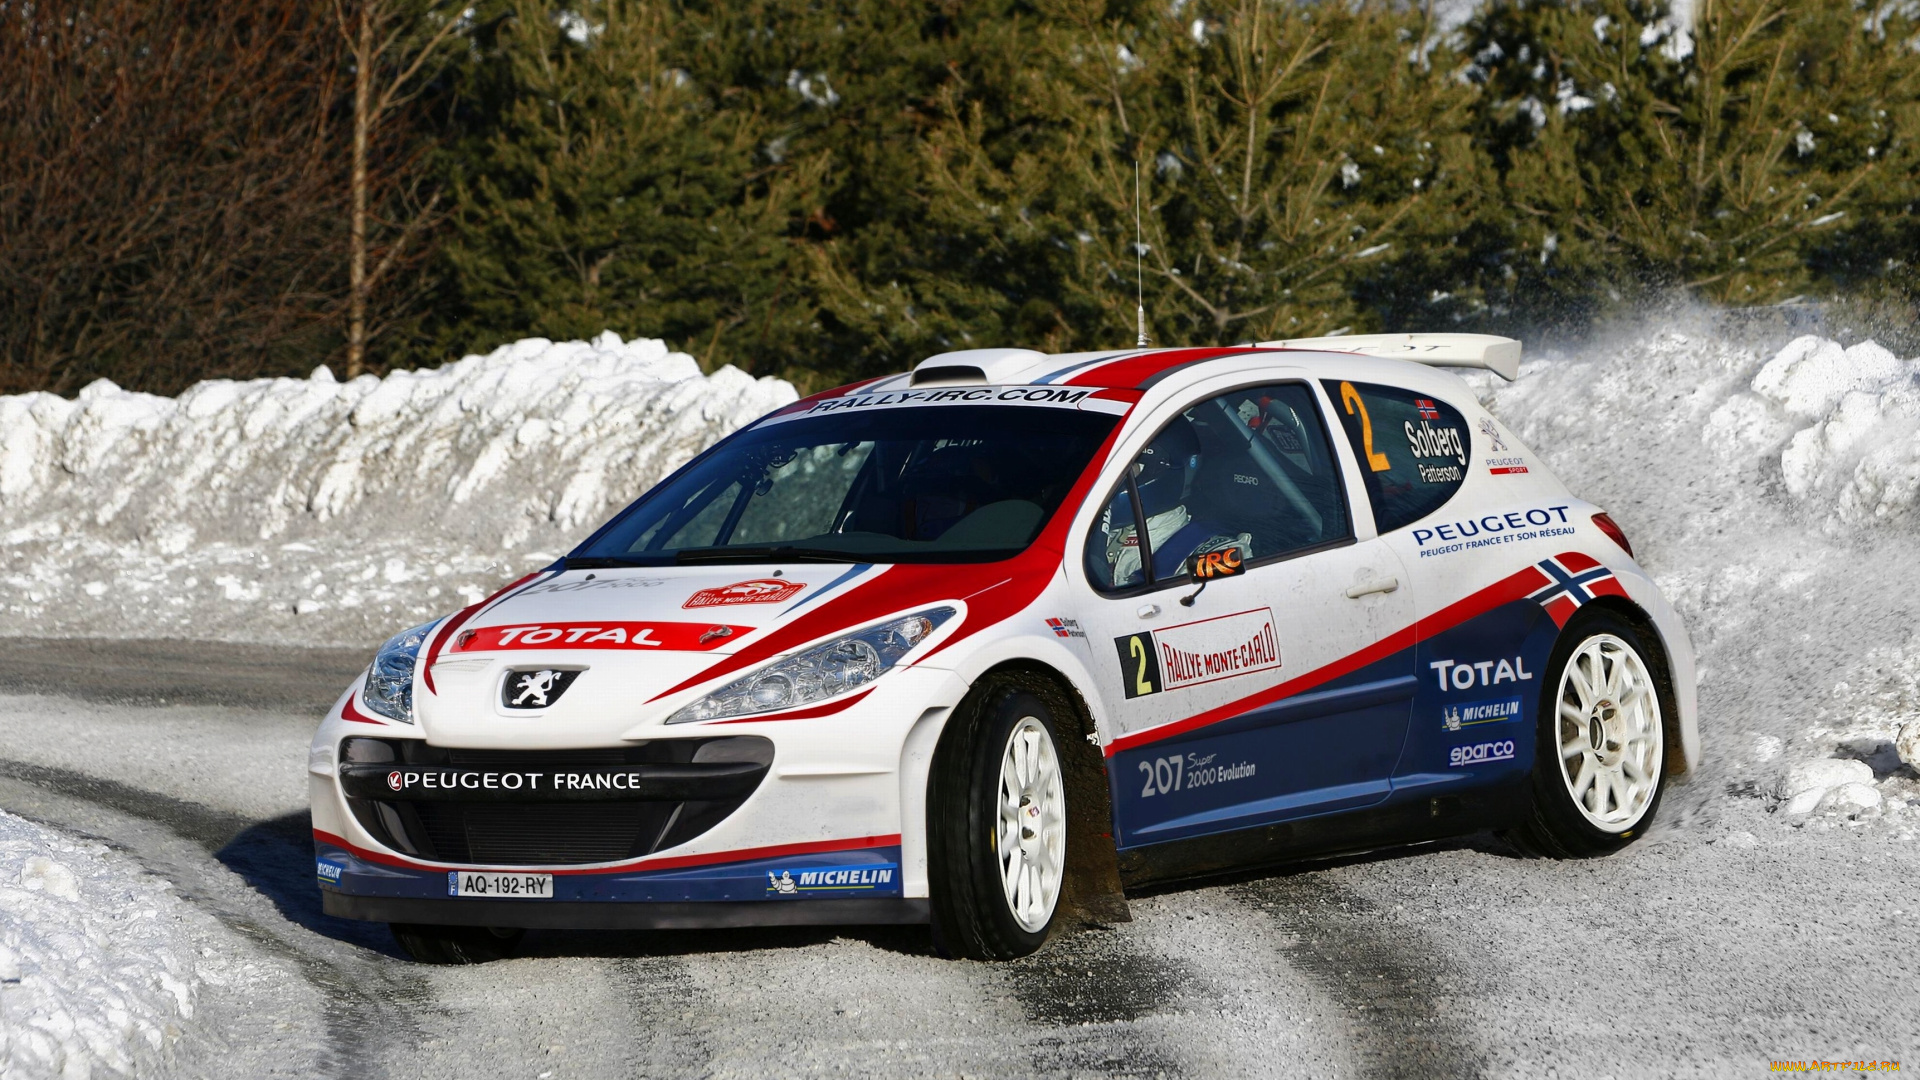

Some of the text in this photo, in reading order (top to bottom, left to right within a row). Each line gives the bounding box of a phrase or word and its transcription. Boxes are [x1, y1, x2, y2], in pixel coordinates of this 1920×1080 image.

[808, 389, 1089, 414] RALLY-IRC.COM
[1340, 380, 1391, 472] 2
[1404, 420, 1466, 466] Solberg
[1418, 463, 1461, 483] Patterson
[1485, 457, 1524, 466] PEUGEOT
[1233, 473, 1259, 486] RECARO
[1412, 506, 1569, 546] PEUGEOT
[1420, 527, 1575, 558] PEUGEOT FRANCE ET SON RÉSEAU
[690, 595, 725, 607] RALLYE
[1130, 635, 1152, 695] 2
[1162, 642, 1203, 683] RALLYE
[1462, 701, 1519, 721] MICHELIN
[1186, 752, 1217, 770] Super
[1450, 740, 1514, 766] sparco
[404, 772, 641, 790] PEUGEOT FRANCE
[1138, 754, 1184, 798] 207
[1187, 761, 1256, 789] 2000 Evolution
[317, 862, 341, 879] MICHELIN
[799, 869, 893, 885] MICHELIN
[450, 875, 546, 896] F AQ-192-RY
